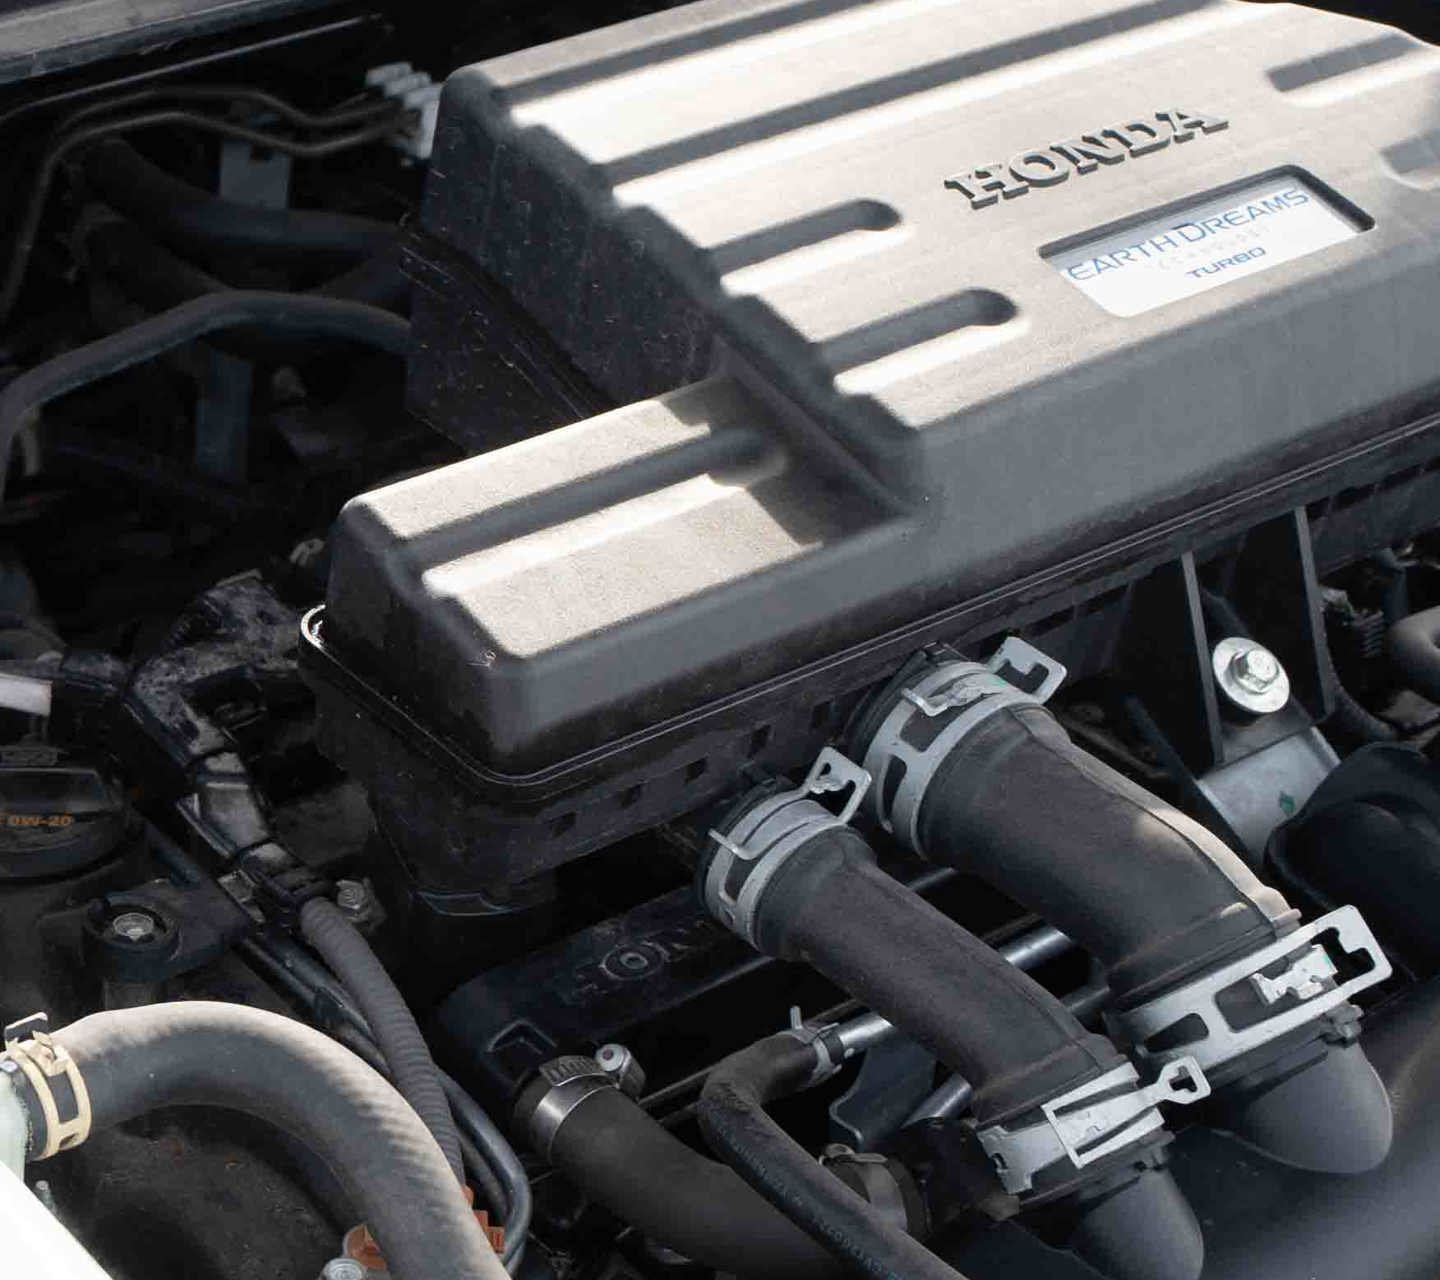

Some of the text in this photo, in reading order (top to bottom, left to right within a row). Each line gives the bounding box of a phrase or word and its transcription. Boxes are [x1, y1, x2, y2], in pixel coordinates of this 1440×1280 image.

[945, 106, 1229, 210] HONDA
[1067, 232, 1180, 282] EARTH
[1178, 188, 1310, 243] DREAMS
[1186, 246, 1267, 279] TURBO
